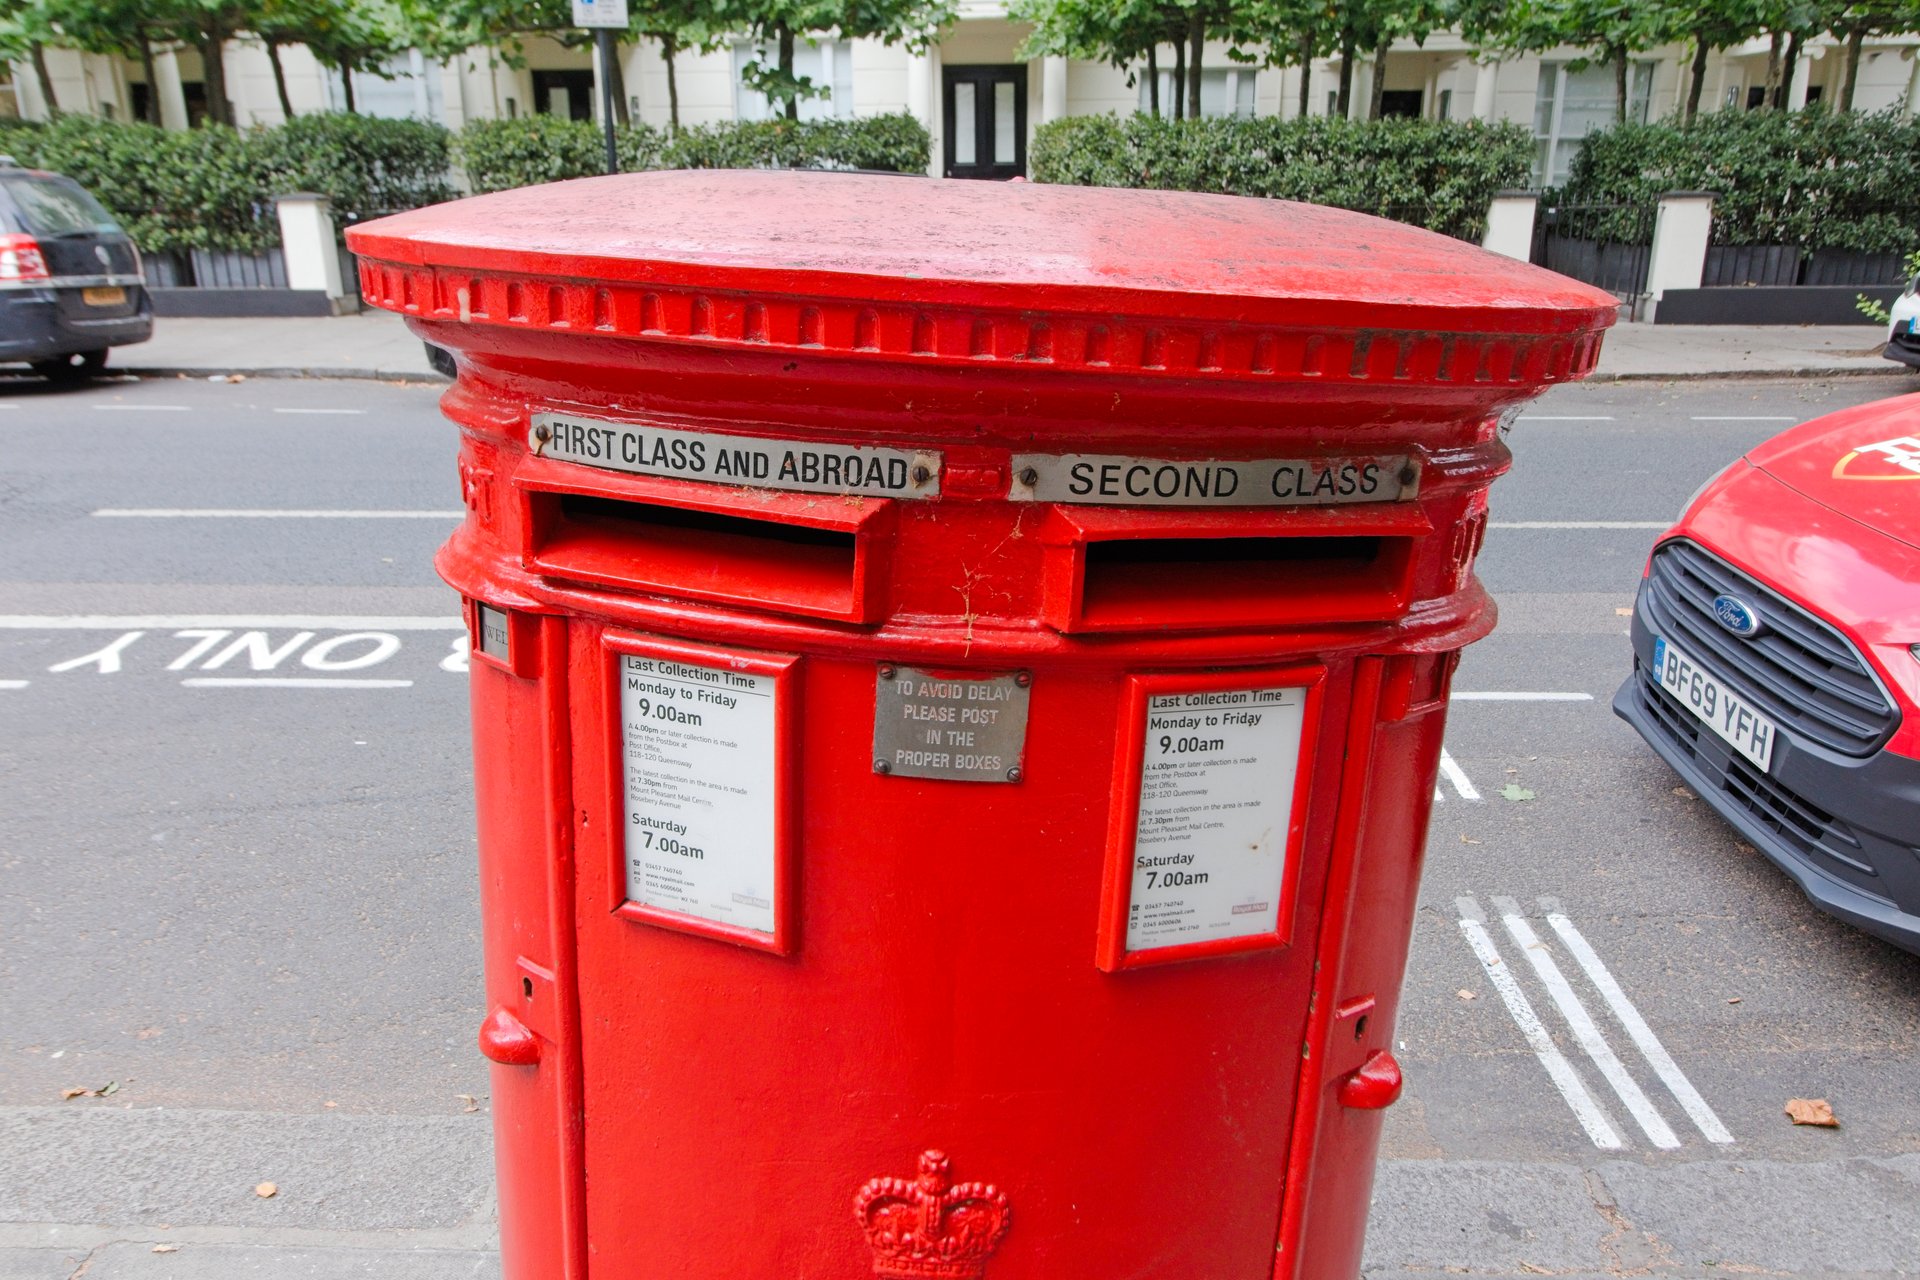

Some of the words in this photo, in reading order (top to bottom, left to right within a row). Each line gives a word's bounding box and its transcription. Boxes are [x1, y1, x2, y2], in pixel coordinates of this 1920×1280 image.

[553, 422, 616, 459] FIRST
[622, 433, 705, 472] CLASS
[715, 449, 768, 478] AND
[778, 451, 907, 489] ABROAD
[1069, 463, 1238, 497] SECOND
[1272, 464, 1380, 496] CLASS
[1718, 601, 1744, 627] Ford
[48, 629, 402, 673] ONLY
[628, 657, 654, 672] Last
[659, 662, 719, 682] Collection
[723, 672, 755, 688] Time
[628, 678, 675, 699] Monday
[680, 687, 692, 700] to
[698, 690, 737, 709] Friday
[896, 680, 912, 695] TO
[918, 682, 962, 699] AVOID
[968, 685, 1013, 701] DELAY
[1153, 696, 1180, 708] Last
[1186, 692, 1246, 706] Collection
[1251, 690, 1282, 702] Time
[639, 698, 702, 726] 9.00am
[904, 704, 955, 722] PLEASE
[962, 708, 998, 724] POST
[1666, 652, 1717, 718] BF69
[1724, 695, 1768, 760] YFH
[1150, 716, 1200, 730] Monday
[1206, 715, 1217, 726] to
[1223, 712, 1262, 726] Friday
[629, 732, 643, 740] from
[656, 737, 679, 747] Postbox
[629, 741, 642, 749] Post
[635, 724, 658, 734] 4.00pm
[684, 733, 711, 743] collection
[720, 740, 737, 748] made
[927, 730, 940, 744] IN
[947, 731, 974, 746] THE
[1160, 736, 1224, 754] 9.00am
[658, 756, 692, 768] Queensway
[896, 750, 949, 768] PROPER
[956, 755, 1000, 770] BOXES
[1152, 762, 1177, 771] 4.00pm
[1188, 760, 1201, 768] later
[1203, 758, 1231, 767] collection
[643, 770, 658, 778] latest
[661, 773, 688, 783] collection
[730, 786, 747, 795] made
[1174, 770, 1197, 778] Postbox
[638, 777, 661, 788] 7.30pm
[663, 782, 677, 790] from
[631, 786, 649, 795] Mount
[651, 789, 676, 799] Pleasant
[678, 794, 690, 802] Mail
[1173, 789, 1208, 797] Queensway
[1173, 805, 1201, 814] collection
[632, 813, 687, 836] Saturday
[1139, 827, 1159, 835] Mount
[1161, 824, 1187, 833] Pleasant
[1189, 823, 1201, 831] Mail
[1148, 817, 1173, 825] 7.30pm
[642, 831, 704, 860] 7.00am
[1138, 835, 1166, 844] Rosebery
[1137, 853, 1194, 867] Saturday
[1146, 871, 1208, 889] 7.00am
